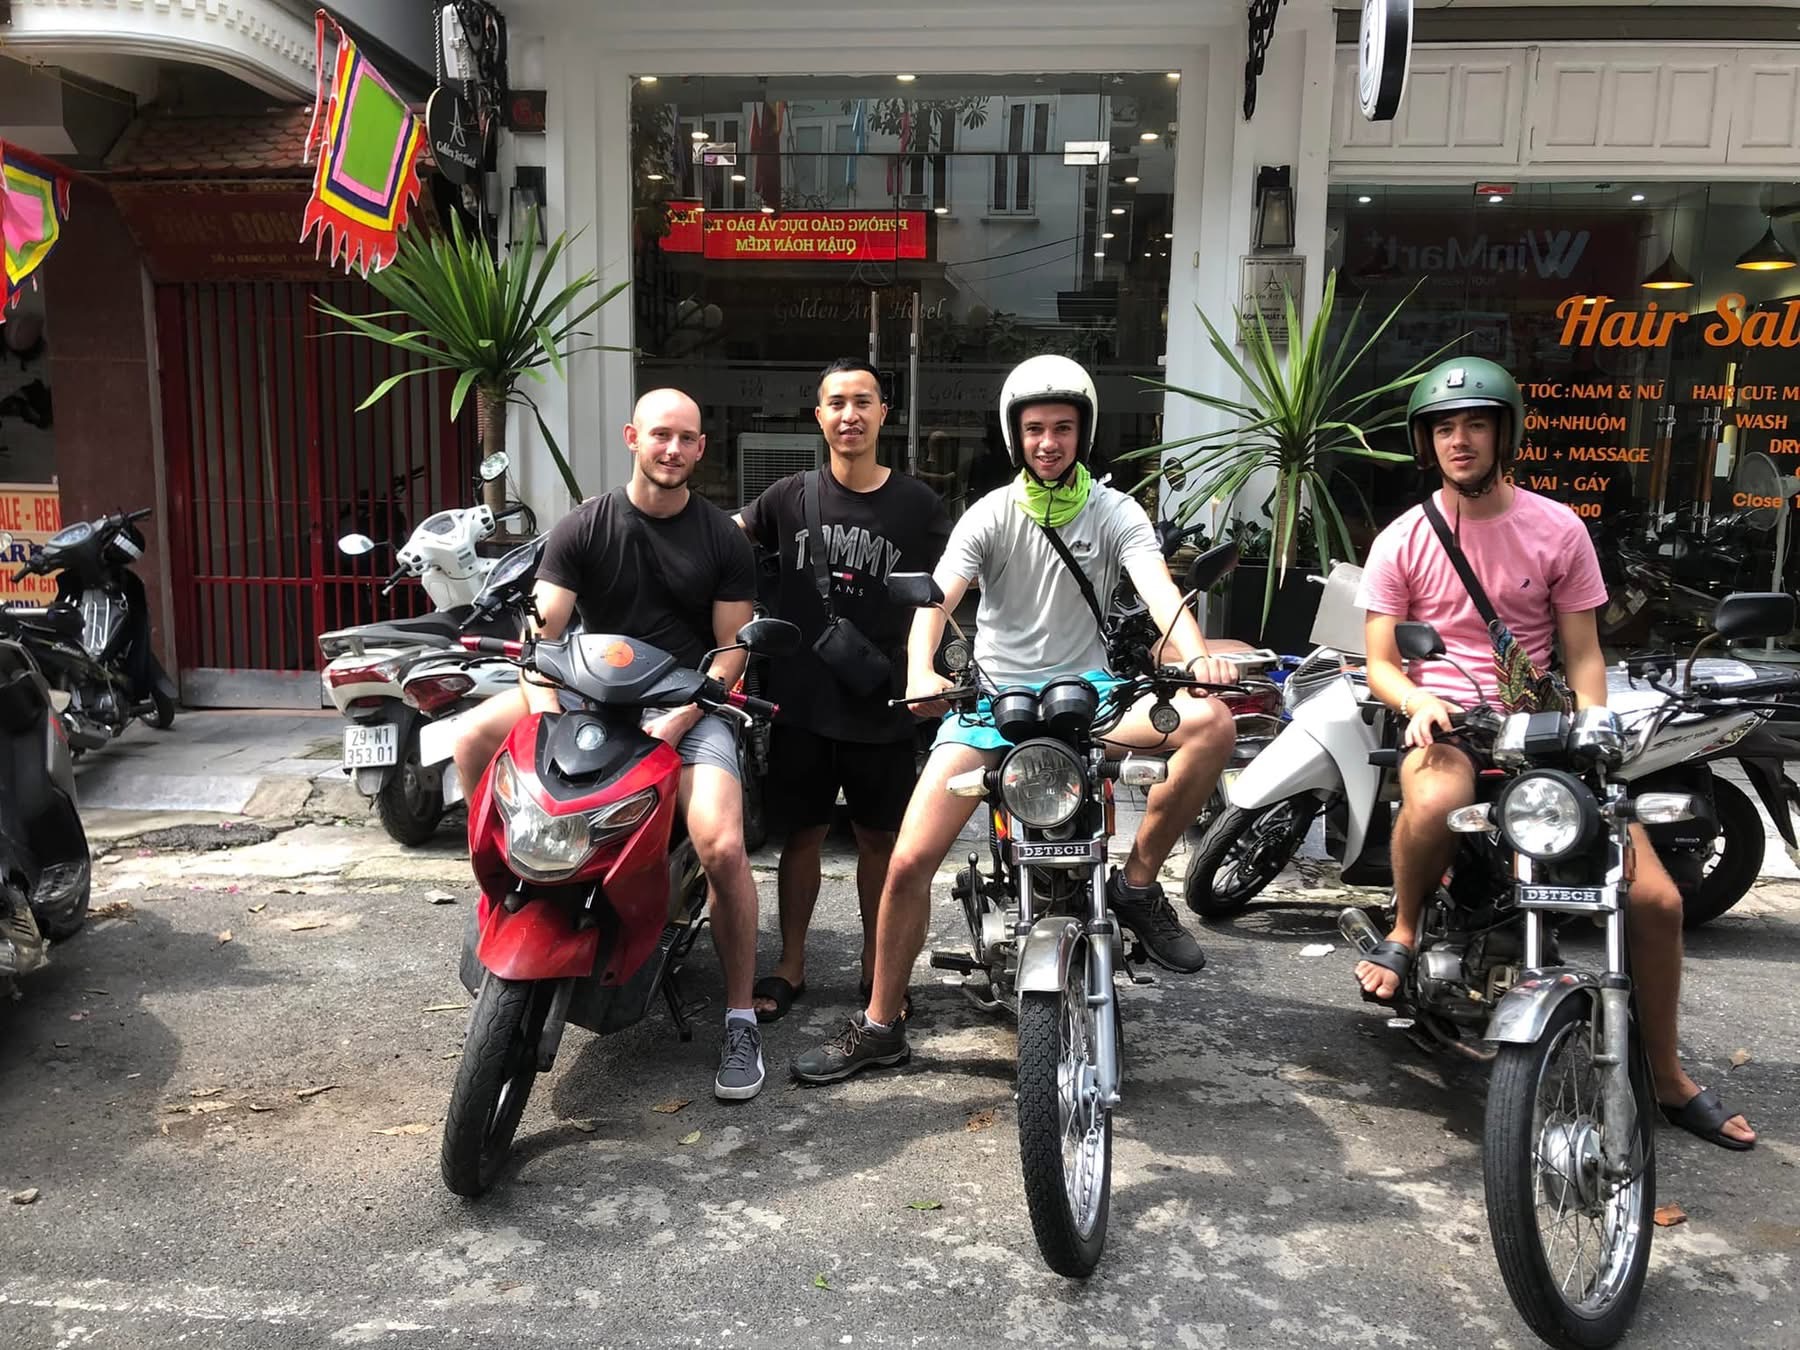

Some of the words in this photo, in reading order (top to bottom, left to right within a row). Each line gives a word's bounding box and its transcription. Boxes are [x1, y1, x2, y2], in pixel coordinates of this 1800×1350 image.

[841, 299, 880, 323] Ar
[1556, 295, 1689, 347] Hair
[1704, 292, 1800, 348] Sal
[1618, 385, 1632, 399] &
[1692, 385, 1735, 400] HAIR
[1741, 385, 1777, 400] CUT:
[1523, 407, 1627, 434] ỐN+NHUỘM
[1736, 414, 1788, 430] WASH
[1553, 450, 1563, 460] +
[1568, 446, 1650, 462] MASSAGE
[1529, 476, 1558, 490] VAI
[1574, 471, 1611, 491] GÁY
[1733, 492, 1783, 507] Close
[23, 577, 35, 593] IN
[834, 583, 865, 597] ANS
[1024, 845, 1085, 857] DETECH
[1527, 889, 1597, 902] DETECH
